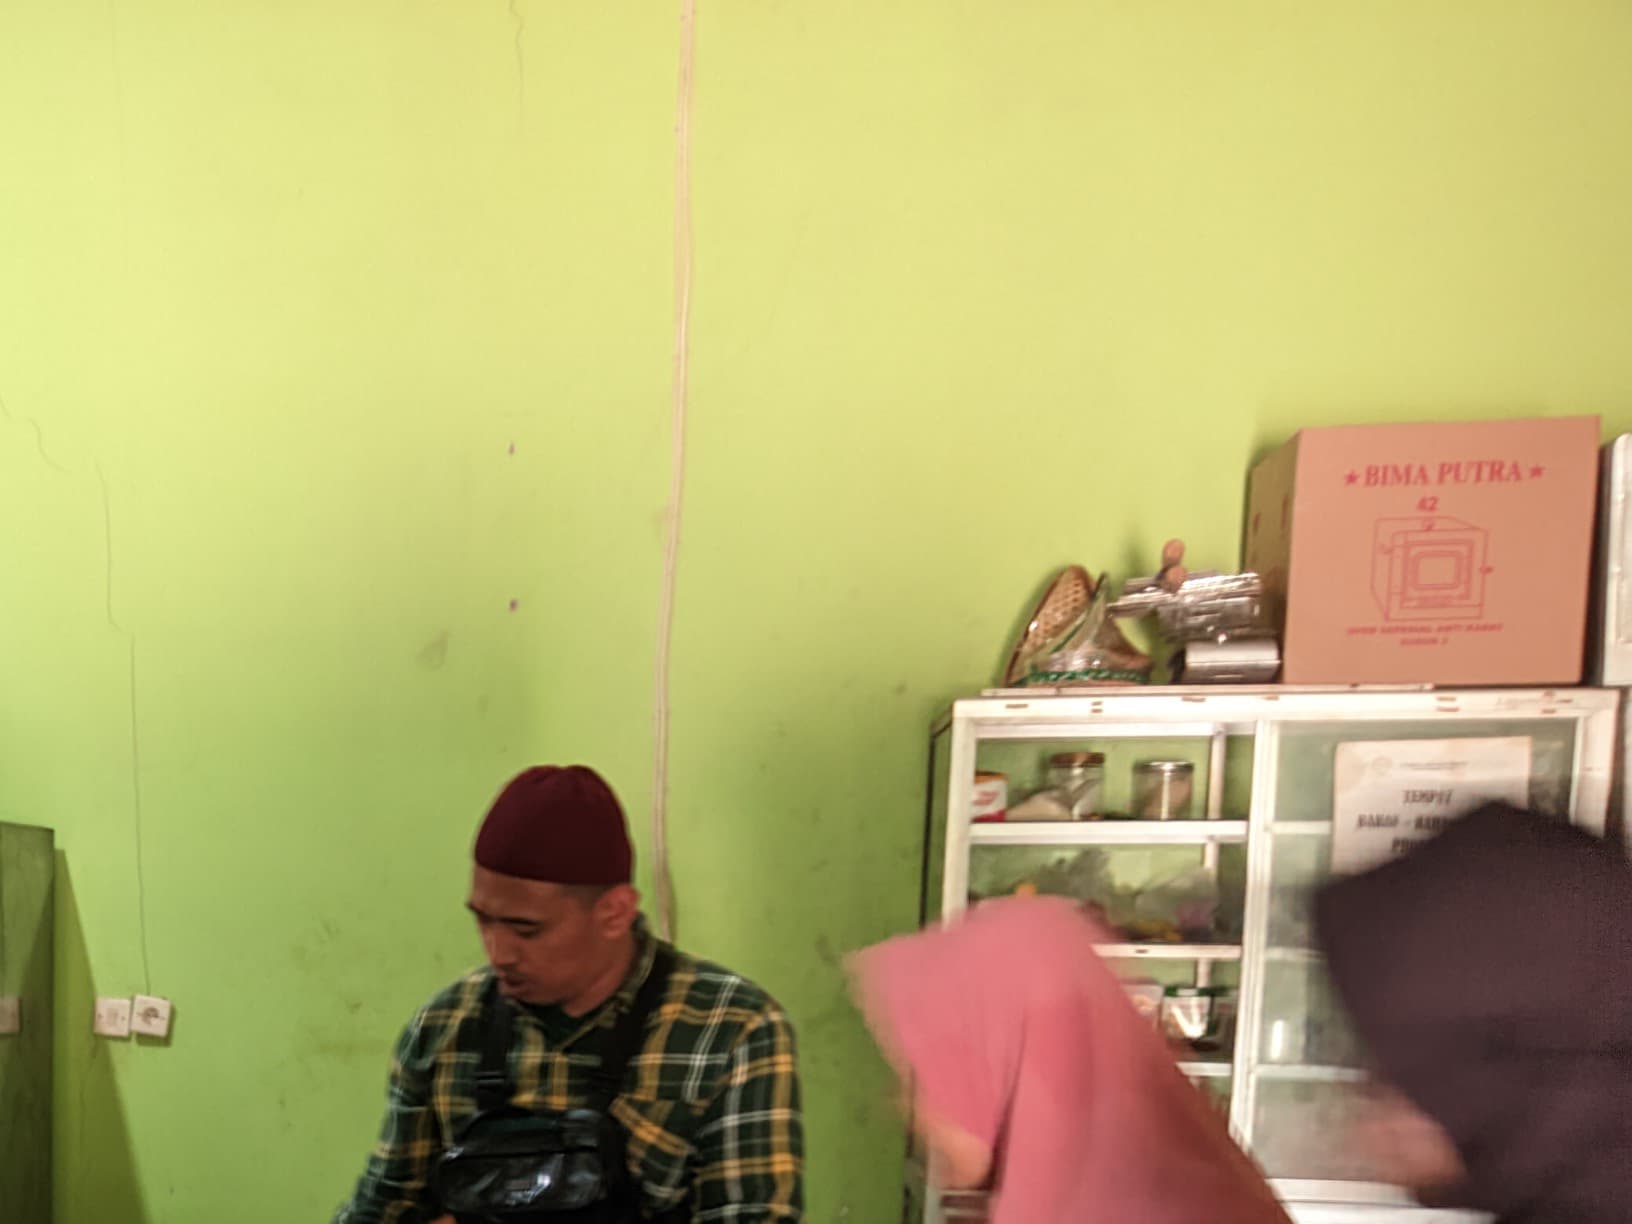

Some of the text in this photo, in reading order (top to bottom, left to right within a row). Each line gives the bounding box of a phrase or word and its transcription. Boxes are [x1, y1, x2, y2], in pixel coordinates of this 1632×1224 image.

[1364, 459, 1523, 487] BIMA PUTRA
[1416, 495, 1441, 513] 42
